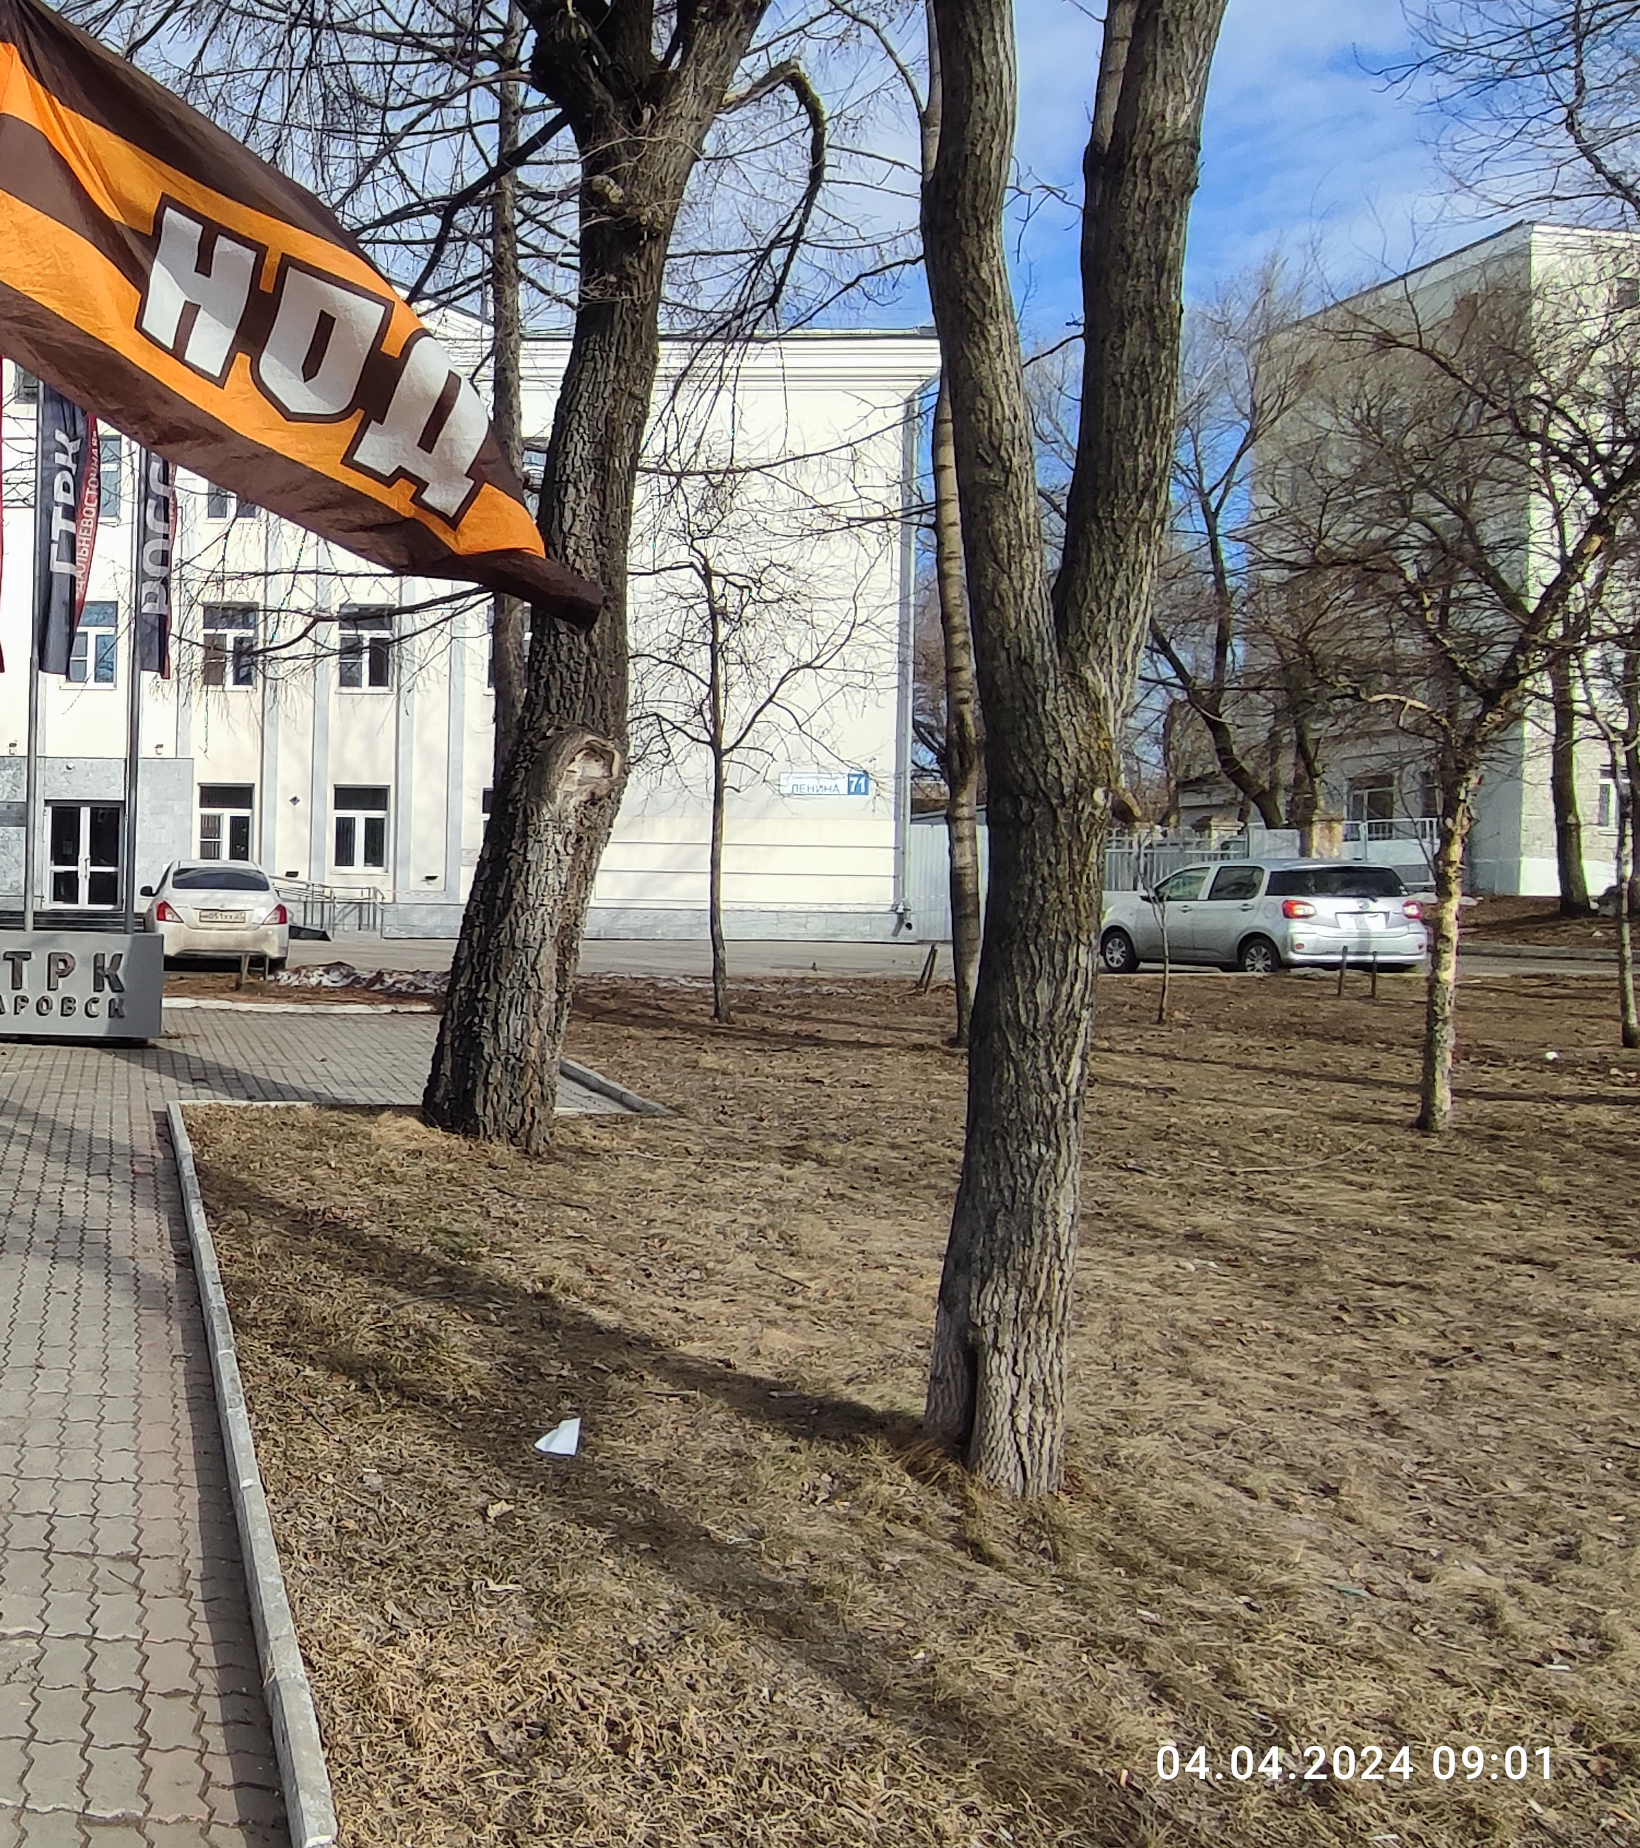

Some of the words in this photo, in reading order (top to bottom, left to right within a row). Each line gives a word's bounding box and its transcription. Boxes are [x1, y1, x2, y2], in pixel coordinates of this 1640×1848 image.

[142, 205, 490, 518] НОД
[49, 428, 81, 577] ГТРК
[141, 452, 170, 615] РОСС
[791, 783, 840, 794] ЛЕНИНА
[849, 776, 867, 793] 71
